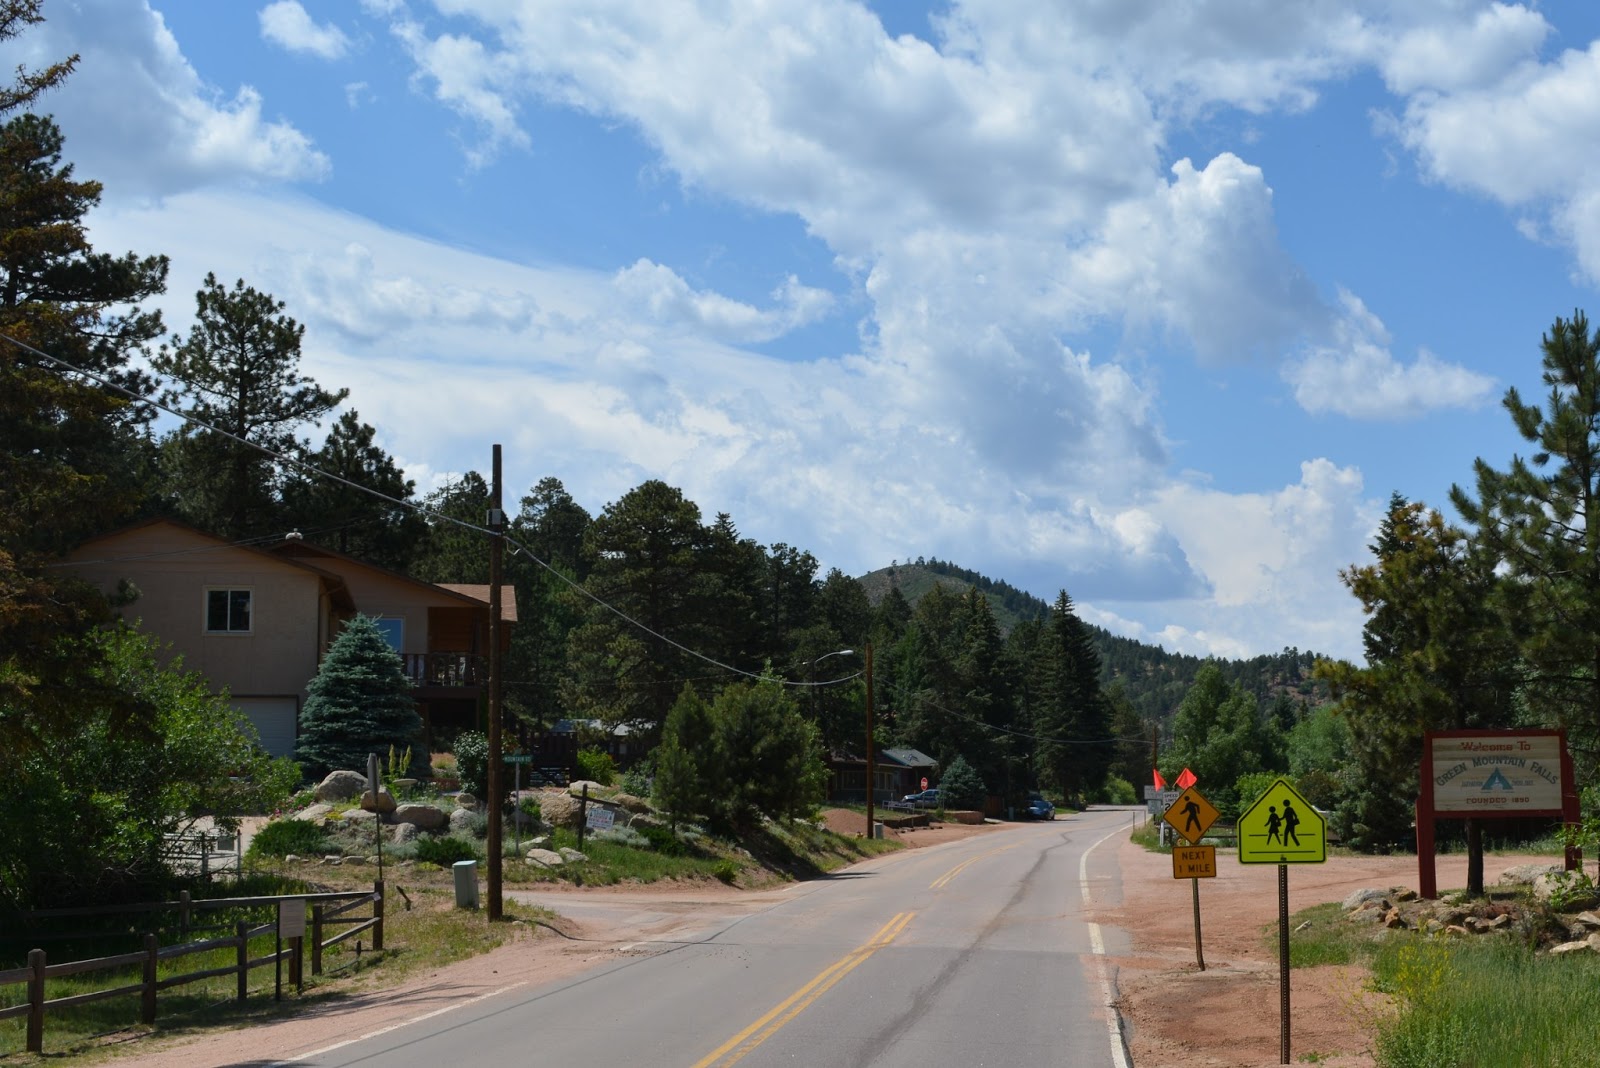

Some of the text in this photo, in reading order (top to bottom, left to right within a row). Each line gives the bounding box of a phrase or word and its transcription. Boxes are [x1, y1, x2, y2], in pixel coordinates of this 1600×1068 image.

[1460, 741, 1531, 751] Welcome To
[1436, 755, 1558, 786] GREEN MOUNTAIN FALLS
[1181, 851, 1206, 860] NEXT
[1188, 863, 1211, 873] MILE
